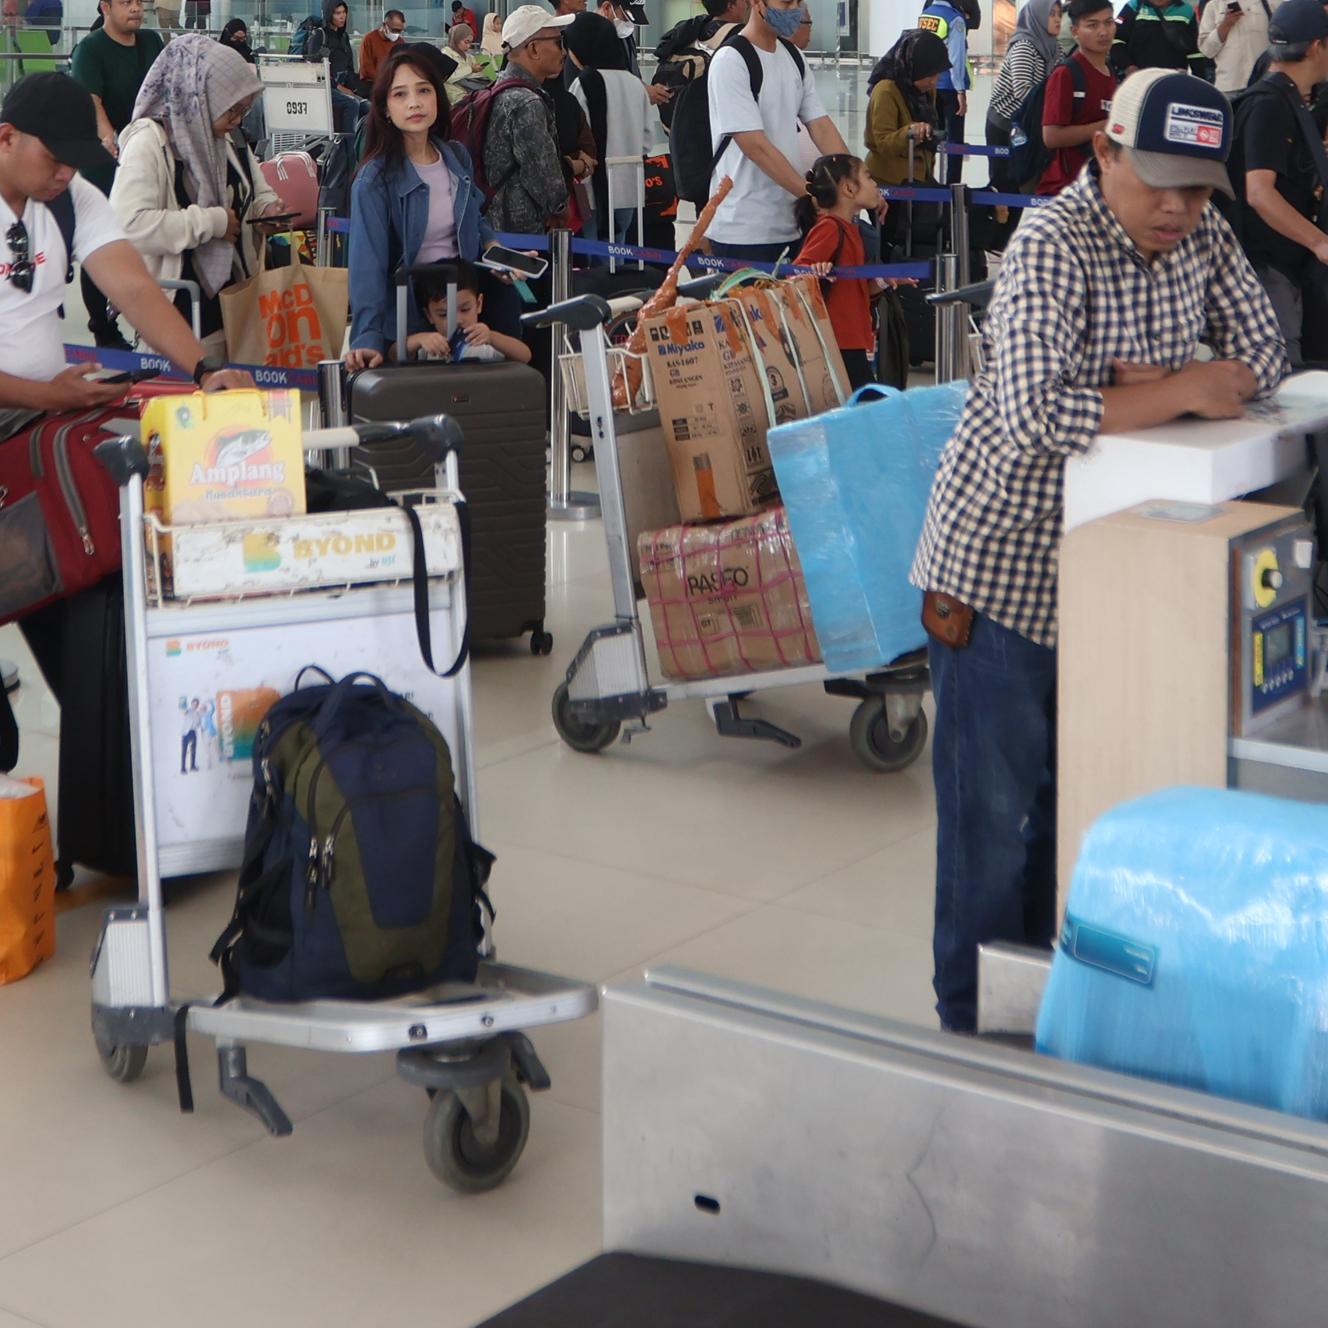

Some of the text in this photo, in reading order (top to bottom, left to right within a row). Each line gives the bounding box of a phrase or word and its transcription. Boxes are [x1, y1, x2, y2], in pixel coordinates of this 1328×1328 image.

[286, 101, 308, 115] 0937
[258, 283, 314, 320] McD
[266, 305, 322, 349] on
[666, 340, 705, 356] Miyako
[191, 462, 285, 487] Amplang
[293, 531, 397, 561] BYOND
